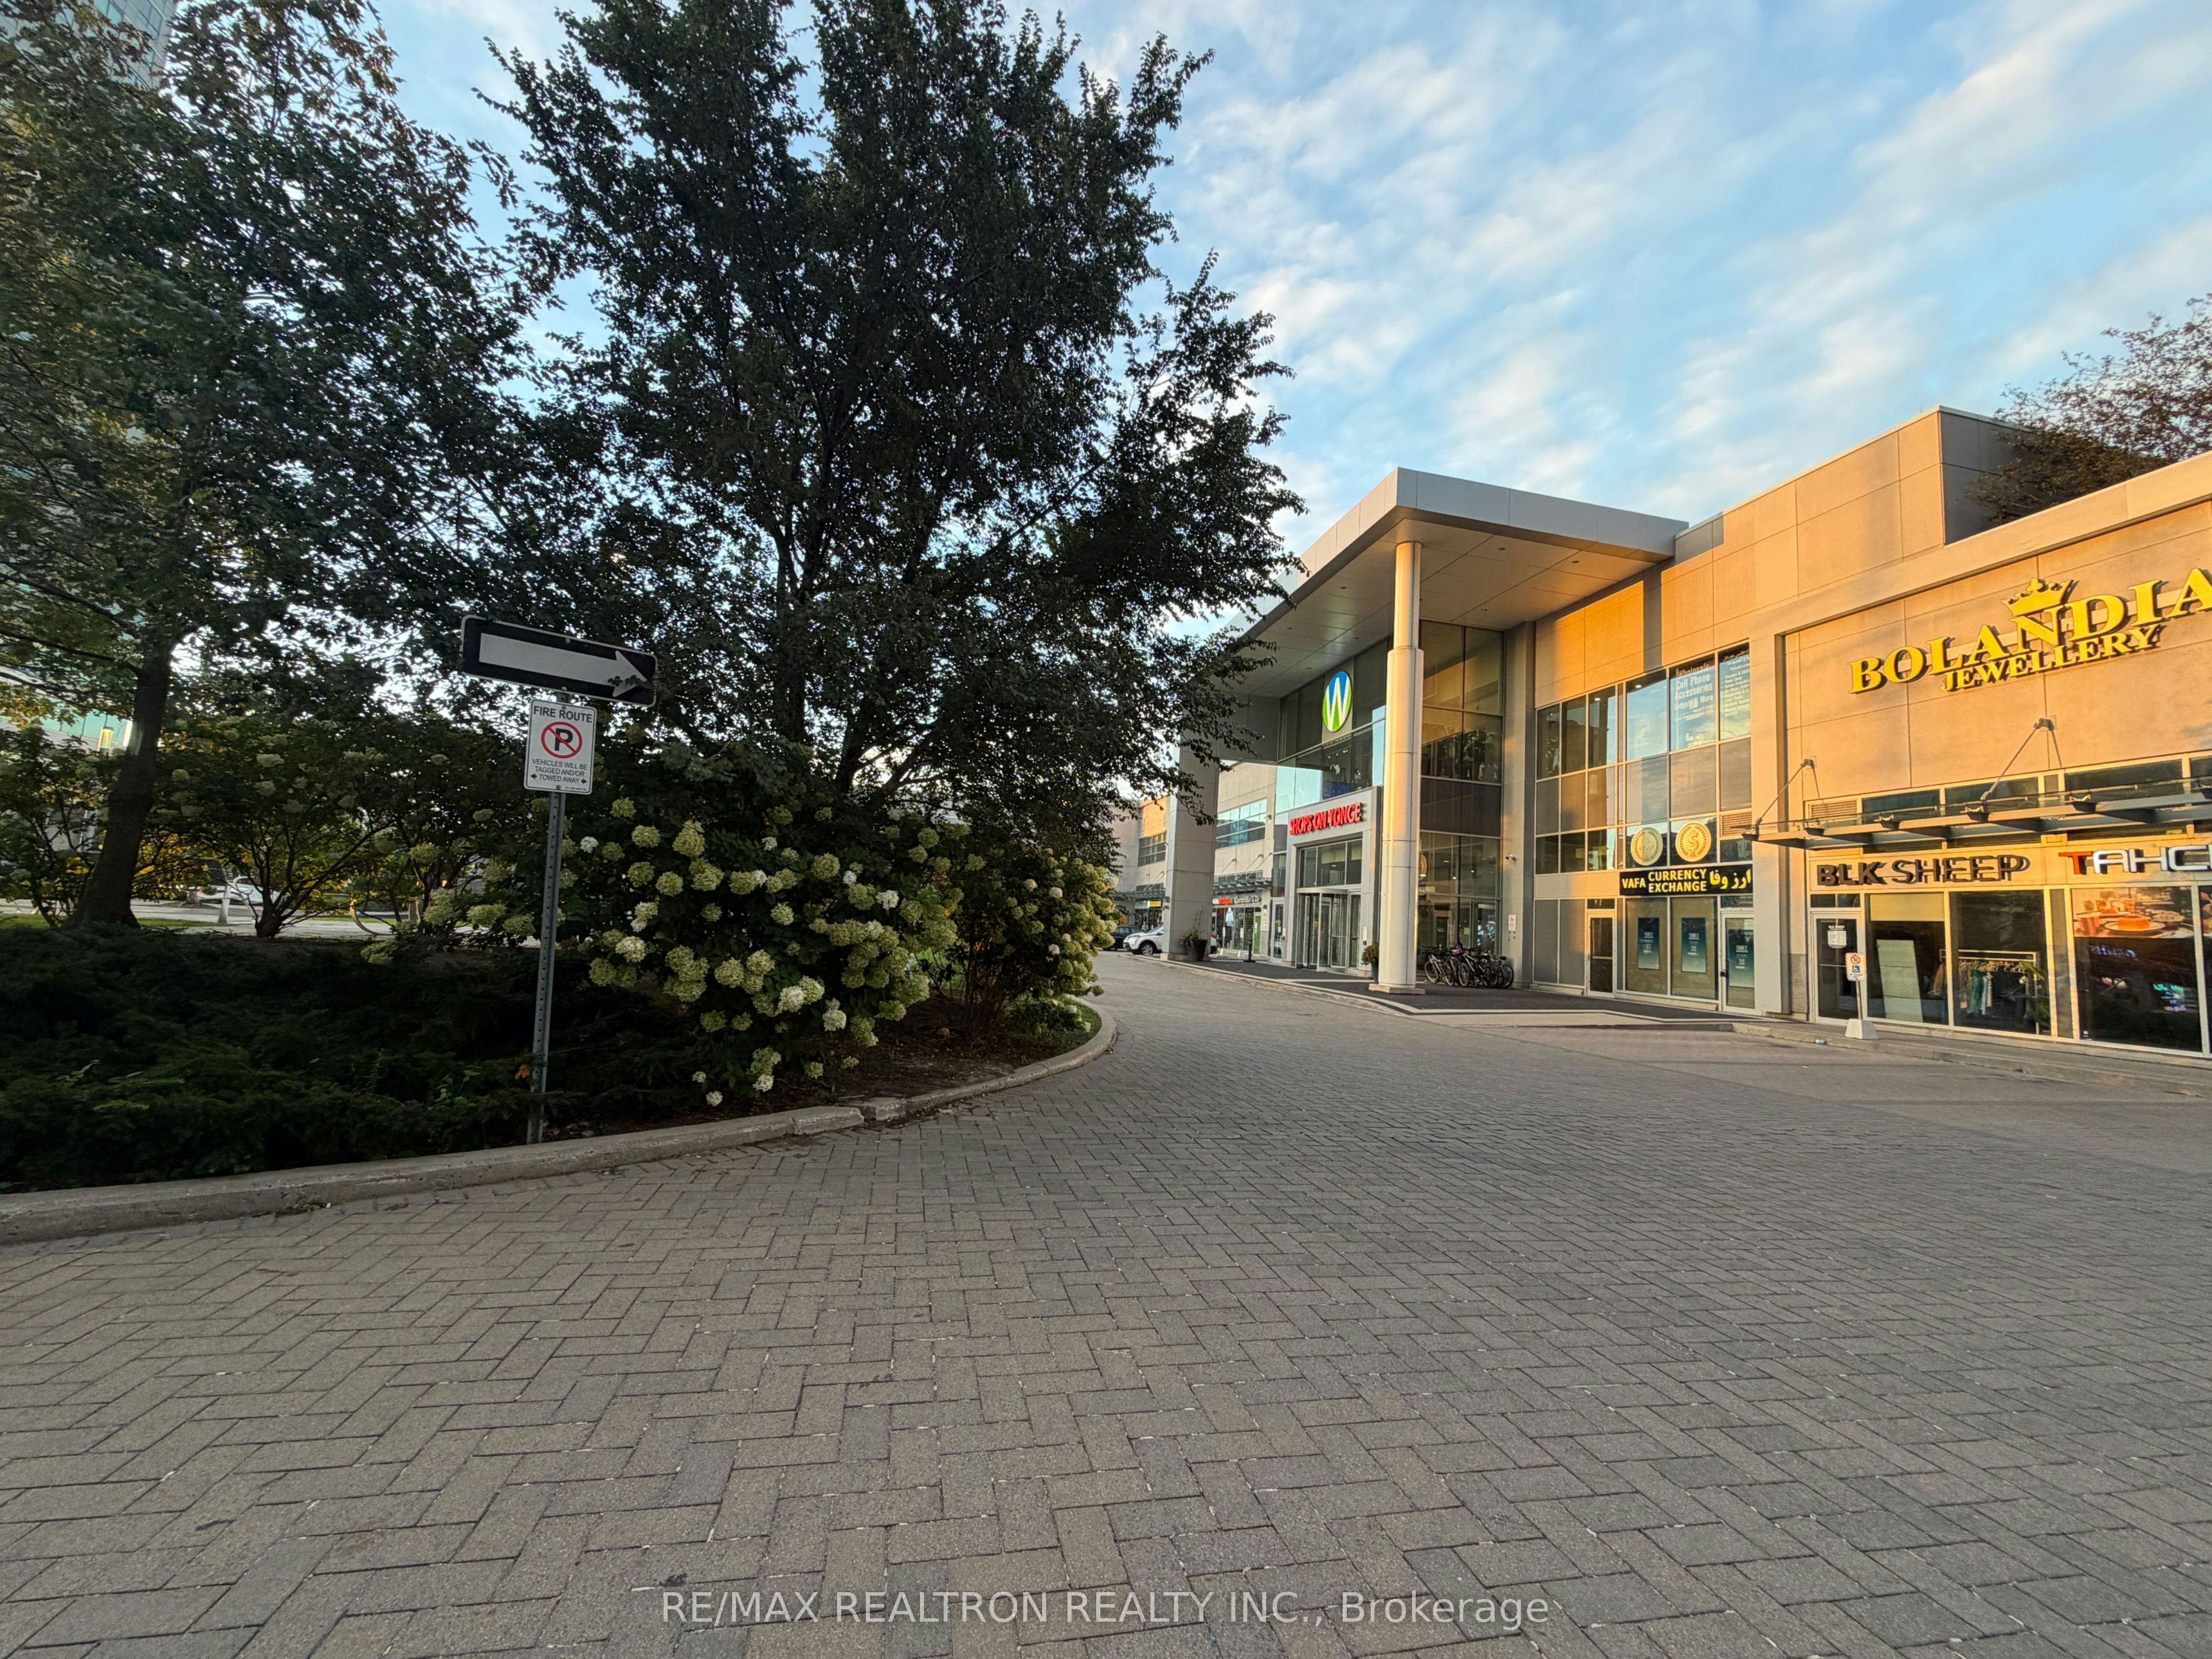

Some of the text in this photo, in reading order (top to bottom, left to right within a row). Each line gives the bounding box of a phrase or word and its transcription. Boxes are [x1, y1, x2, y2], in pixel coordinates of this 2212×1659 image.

[1848, 567, 2212, 694] BOLANDIA
[1940, 624, 2159, 692] JEWELLERY
[1676, 673, 1710, 690] Cell Phone
[1675, 683, 1713, 700] Accessories
[534, 706, 593, 723] FIRE ROUTE
[532, 759, 563, 767] VEHICLES
[564, 762, 578, 770] WILL
[535, 766, 585, 777] TAGGED AND/OR
[539, 774, 562, 782] TOWED
[1289, 802, 1362, 836] SHOPS ON YONGE
[2059, 844, 2212, 875] TAHC
[1648, 869, 1707, 882] CURRENCY
[1817, 854, 2029, 886] BLK SHEEP
[1622, 878, 1646, 889] VAFA
[1648, 881, 1707, 893] EXCHANGE
